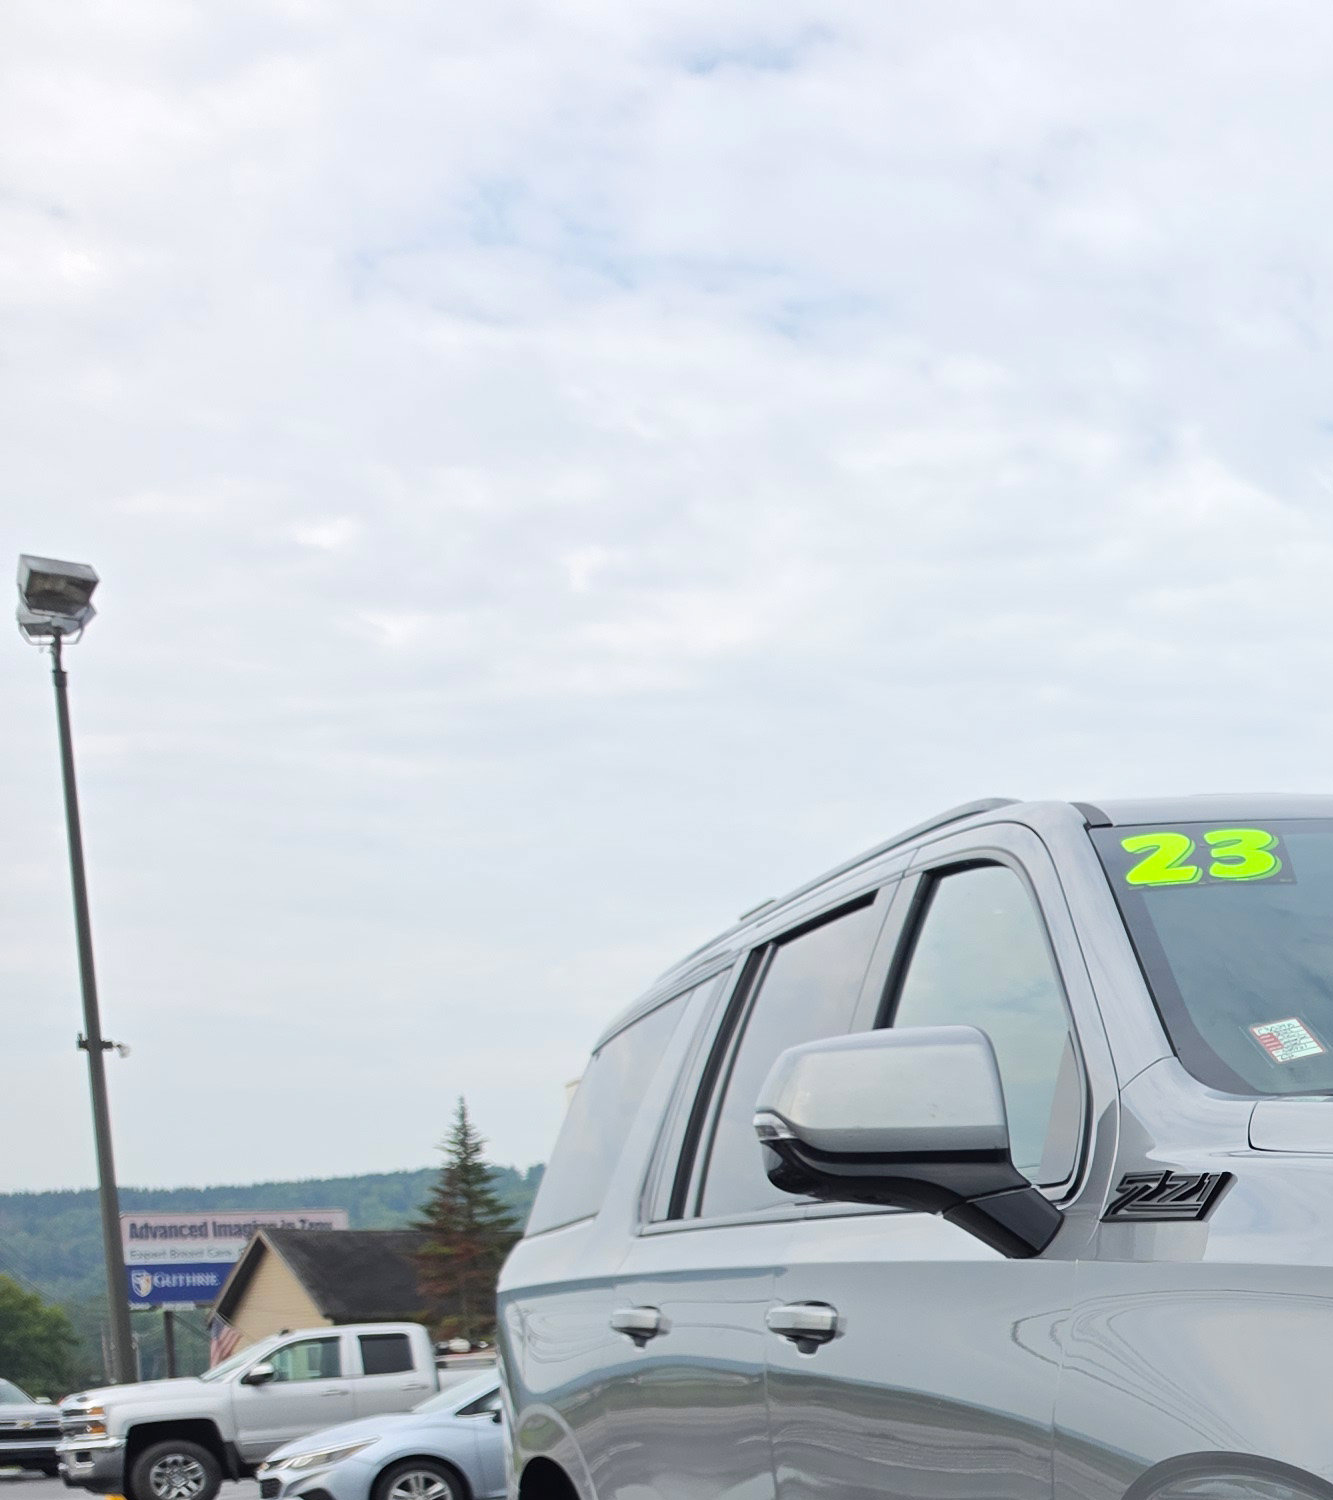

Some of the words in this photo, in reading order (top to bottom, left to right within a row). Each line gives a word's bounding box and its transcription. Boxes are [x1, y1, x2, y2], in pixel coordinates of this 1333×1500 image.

[1120, 828, 1282, 886] 23
[1100, 1169, 1233, 1222] Z71
[129, 1221, 209, 1240] Advanced
